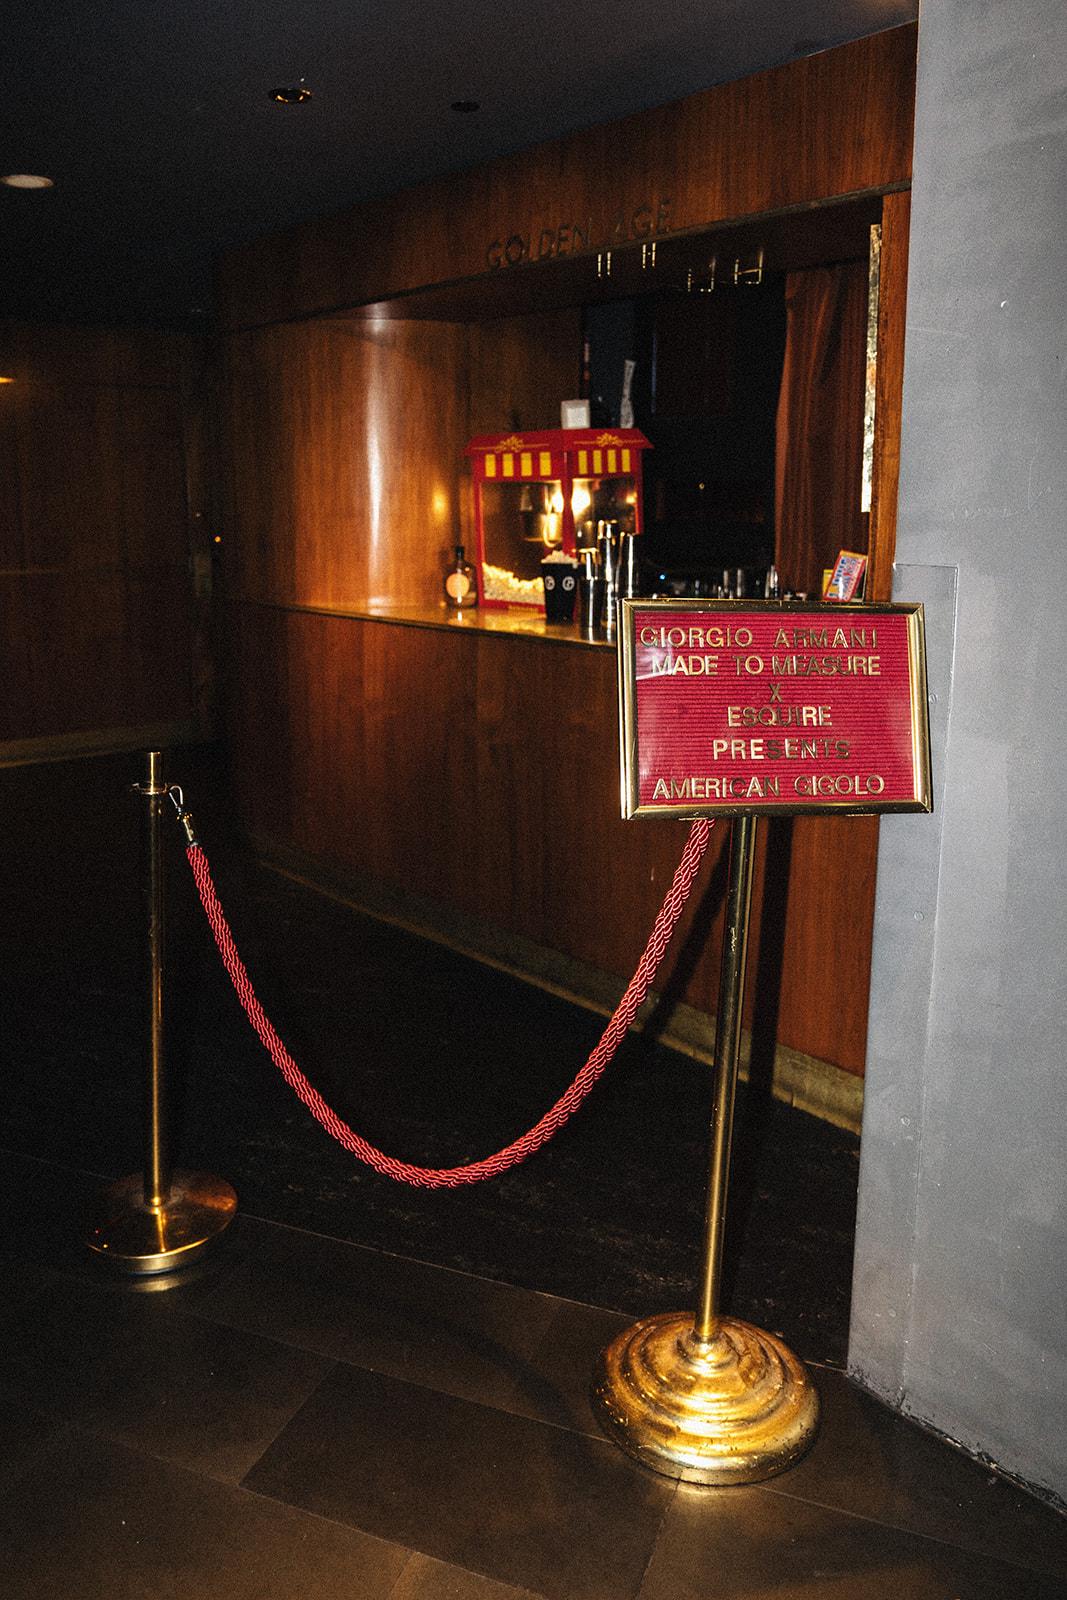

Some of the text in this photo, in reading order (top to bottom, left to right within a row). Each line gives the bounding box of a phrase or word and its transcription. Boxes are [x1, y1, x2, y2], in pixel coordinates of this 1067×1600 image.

[487, 217, 593, 270] GOLDEN
[640, 627, 878, 649] GIORGIO ARMANI
[652, 655, 881, 677] MADE TO MEASURE
[769, 682, 783, 704] X
[727, 706, 833, 727] ESQUIRE
[712, 738, 850, 761] PRESENTS
[652, 774, 885, 800] AMERICAN GIGOLO
